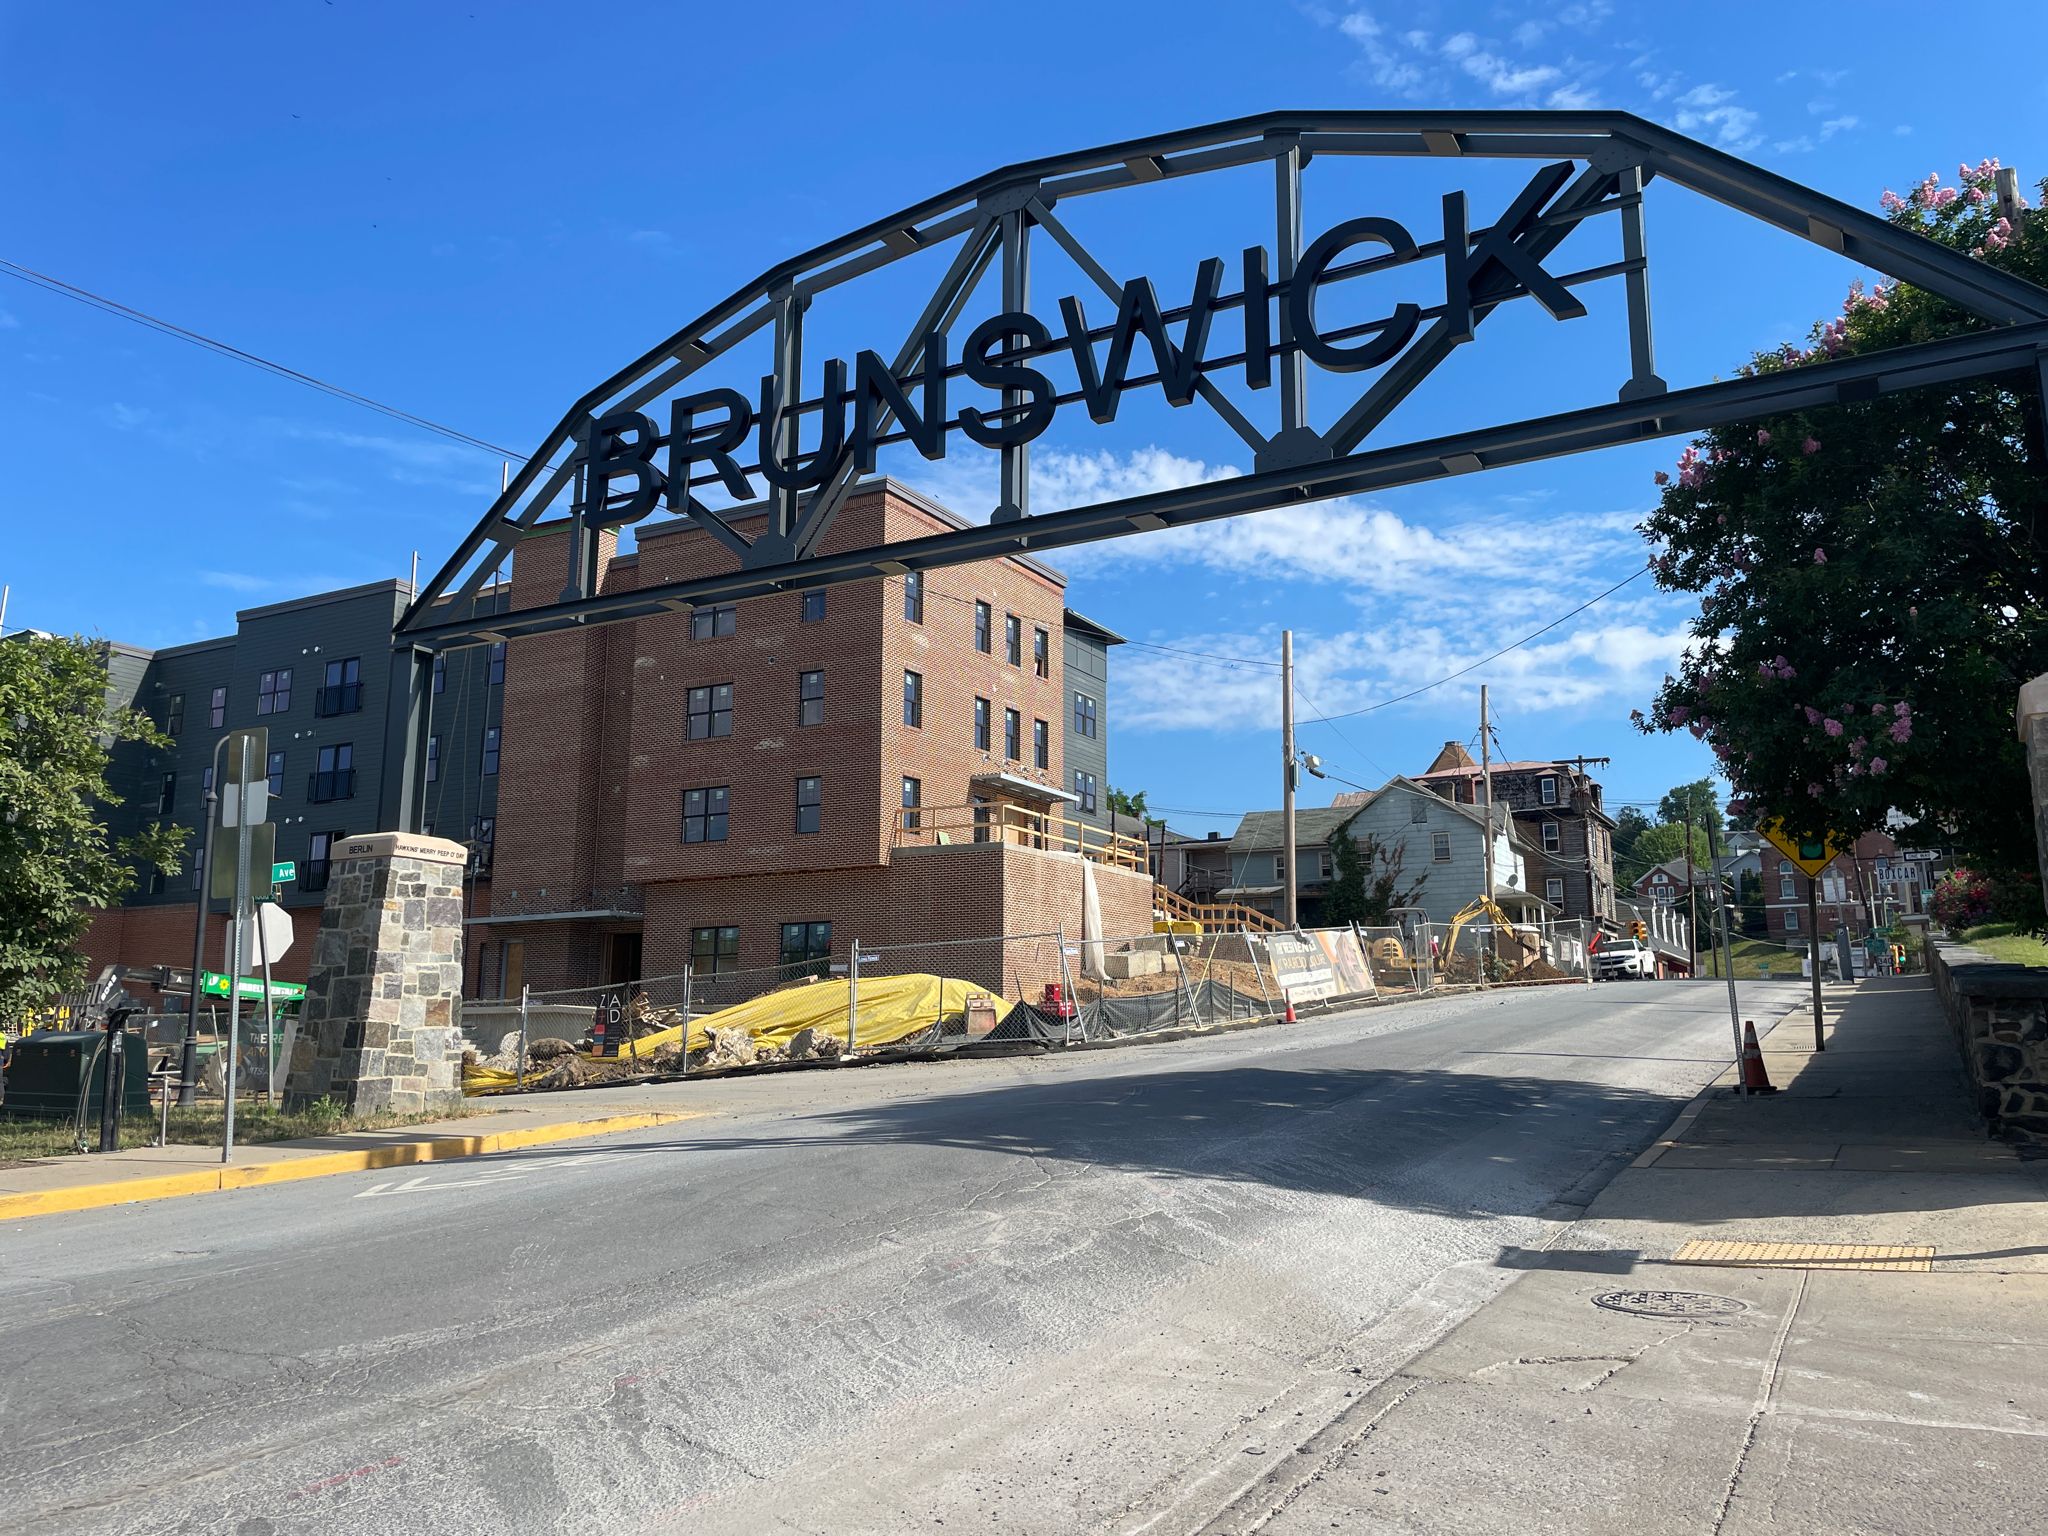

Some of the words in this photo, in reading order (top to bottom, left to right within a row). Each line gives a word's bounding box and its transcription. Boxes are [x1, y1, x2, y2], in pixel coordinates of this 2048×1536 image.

[586, 160, 1587, 528] BRUNSWICK
[348, 844, 374, 855] BERLIN
[395, 844, 418, 852] HAWKINS'
[279, 868, 295, 878] Ave
[1879, 867, 1916, 880] BOXCAR
